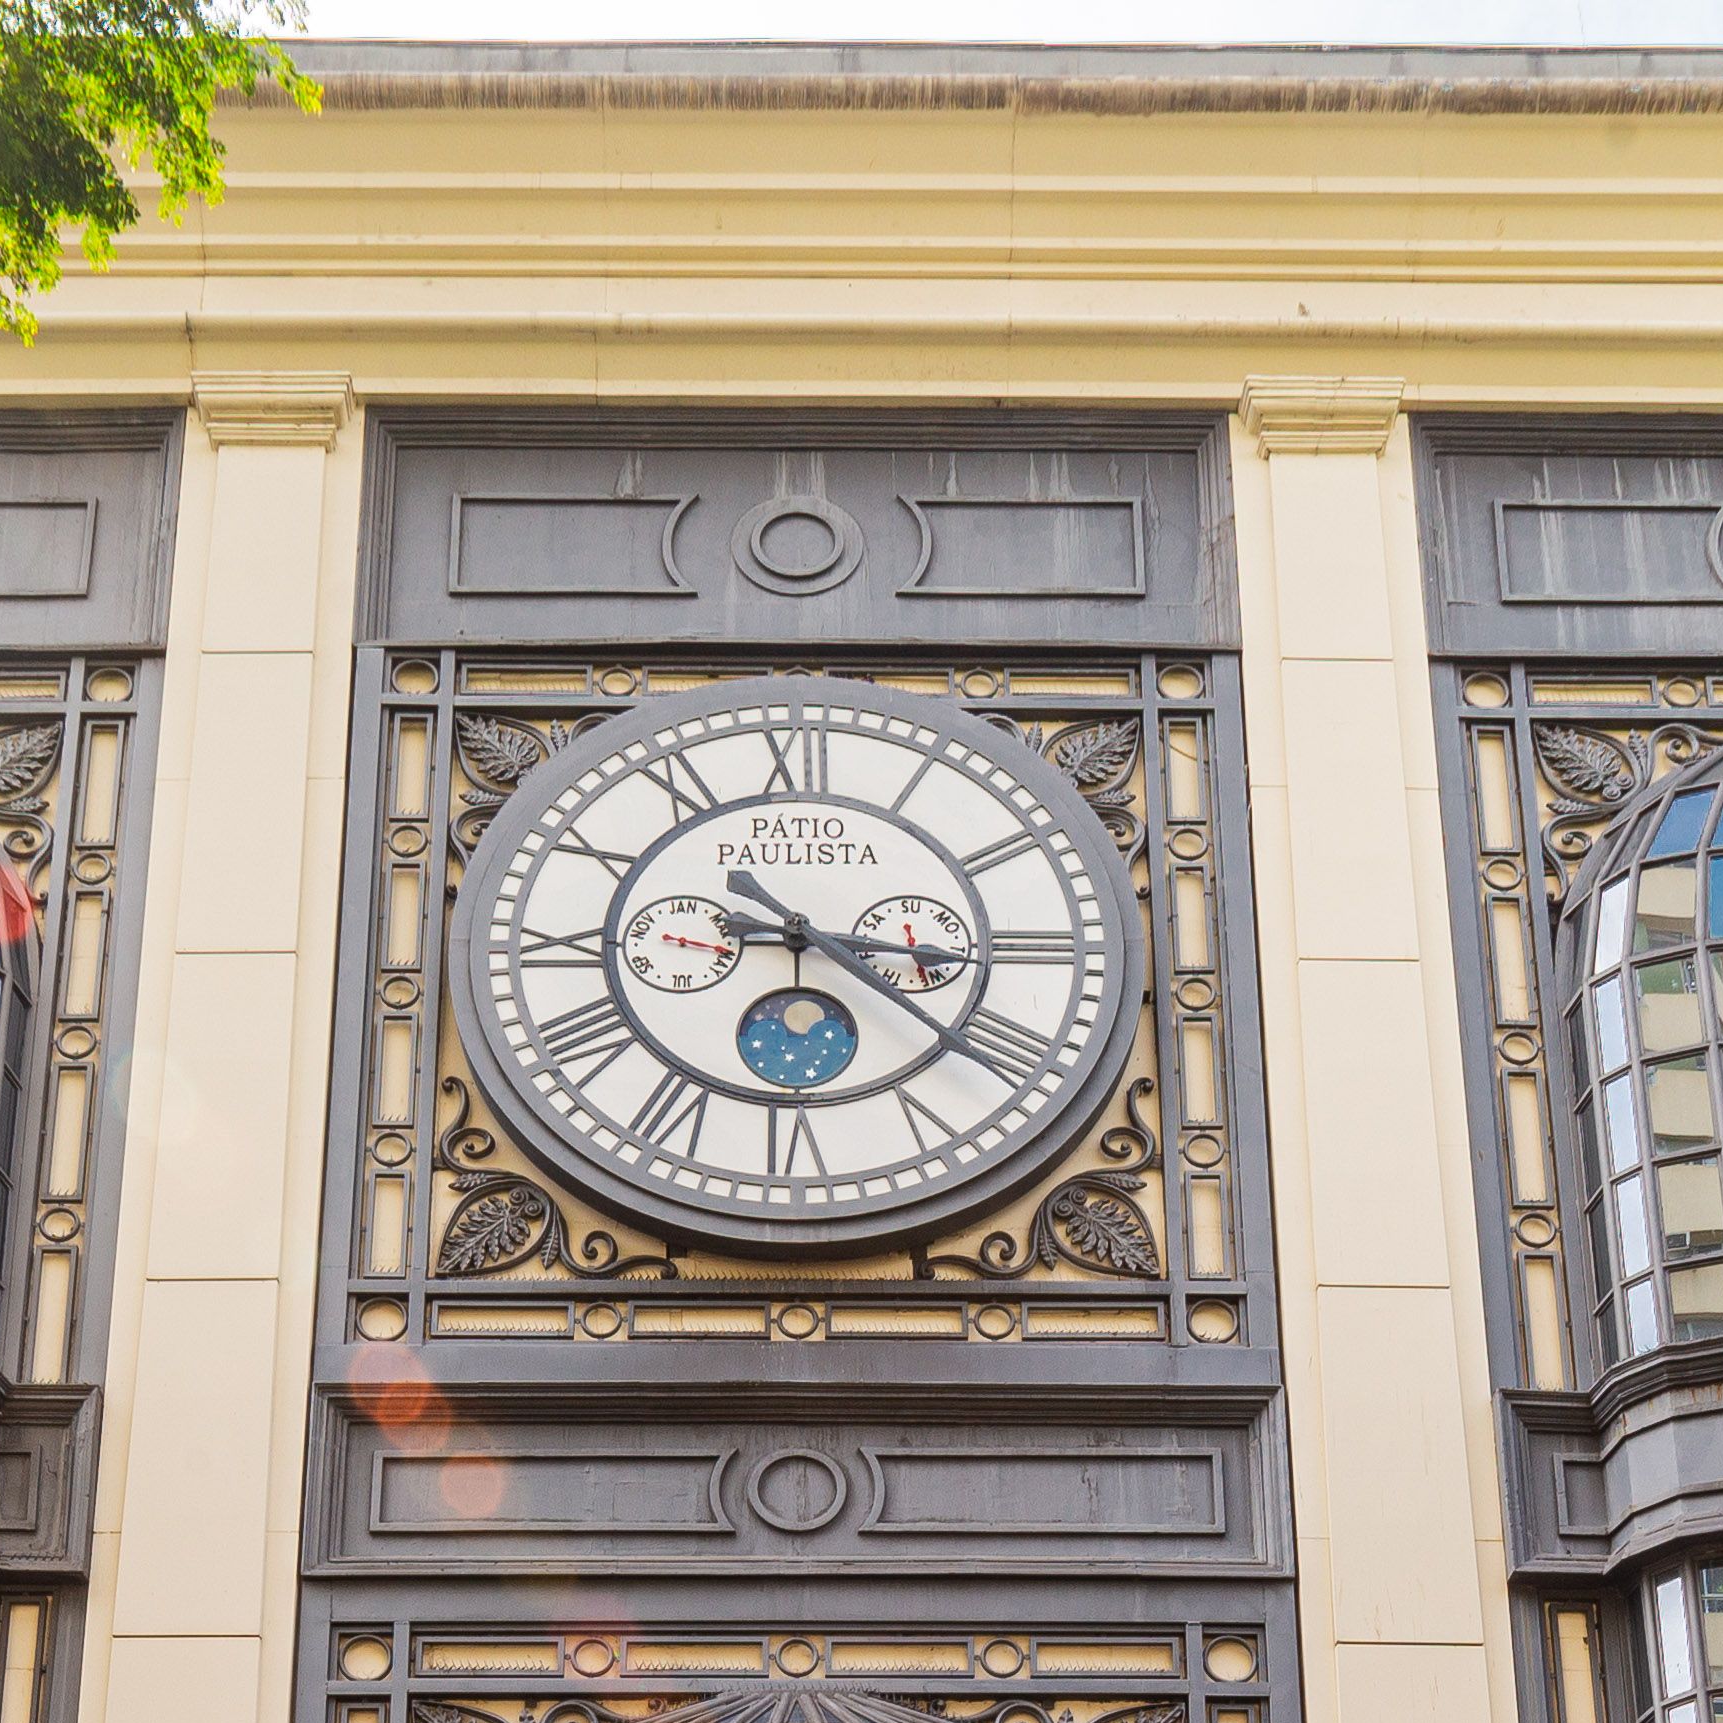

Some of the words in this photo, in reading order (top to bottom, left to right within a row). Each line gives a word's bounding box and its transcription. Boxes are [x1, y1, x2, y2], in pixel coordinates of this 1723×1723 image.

[751, 812, 845, 839] PÁTIO
[717, 843, 879, 866] PAULISTA
[669, 900, 698, 915] JAN
[901, 900, 921, 914] SU
[630, 912, 655, 940] NOV
[863, 912, 886, 931] SA
[933, 911, 960, 934] MO
[672, 974, 693, 988] JUL
